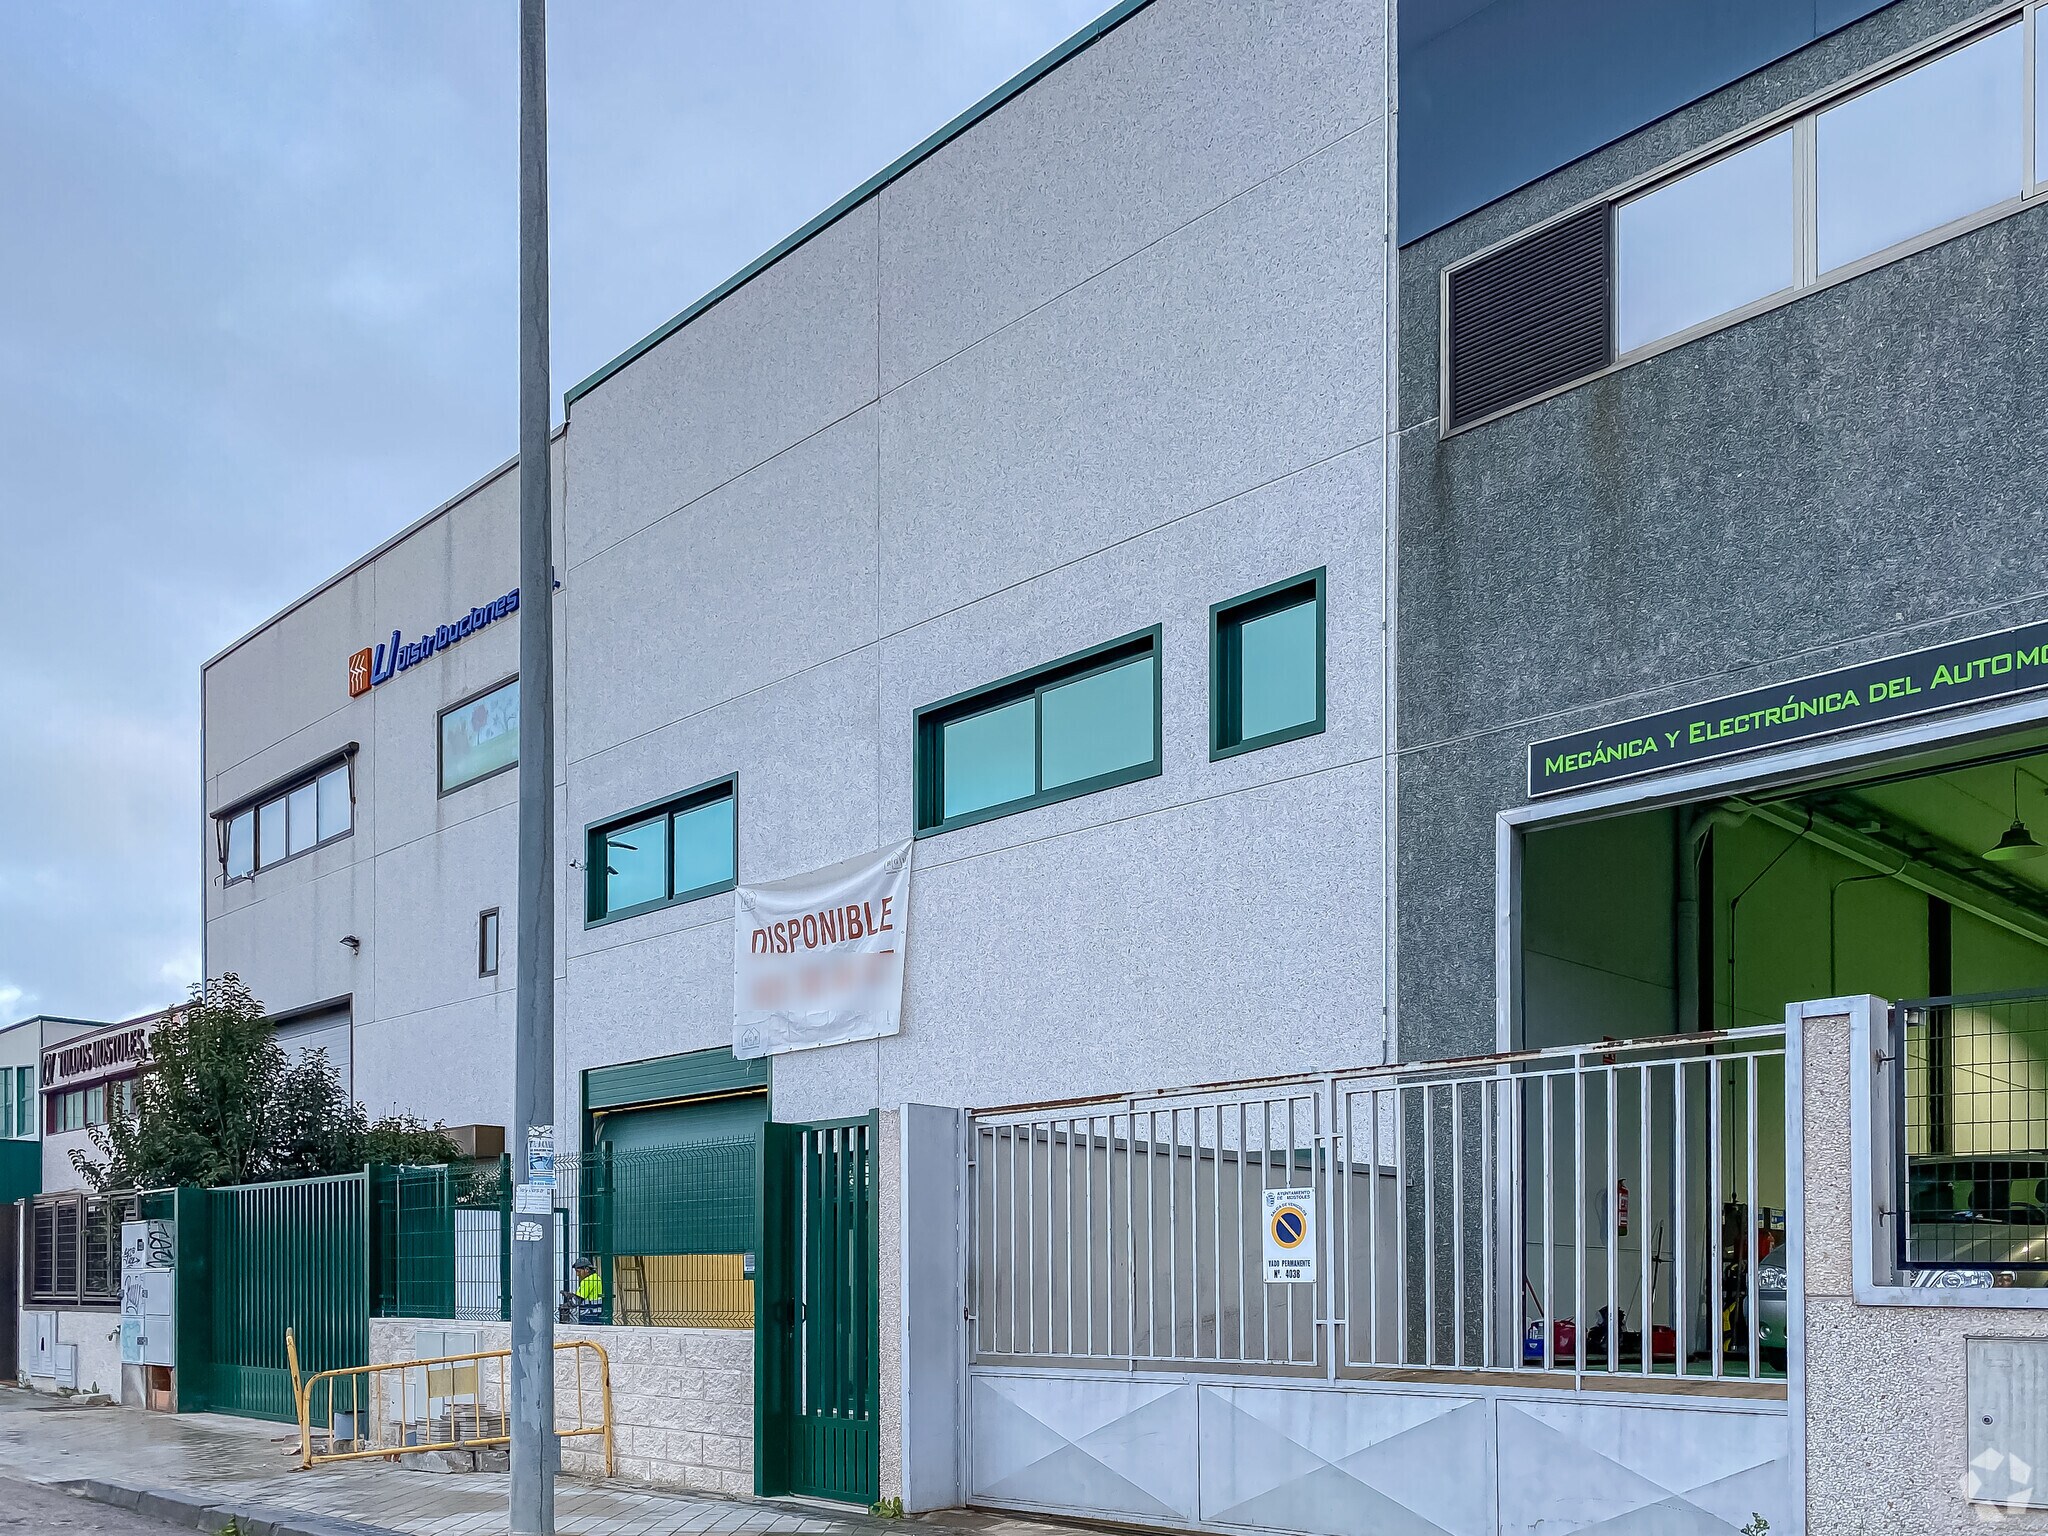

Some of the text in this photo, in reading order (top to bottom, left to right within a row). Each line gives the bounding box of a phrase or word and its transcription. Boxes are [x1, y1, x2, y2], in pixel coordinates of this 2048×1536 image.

[1868, 675, 1922, 704] DEL
[751, 895, 893, 954] DISPONIBLE
[1268, 1259, 1311, 1267] VADO PERMANENTE
